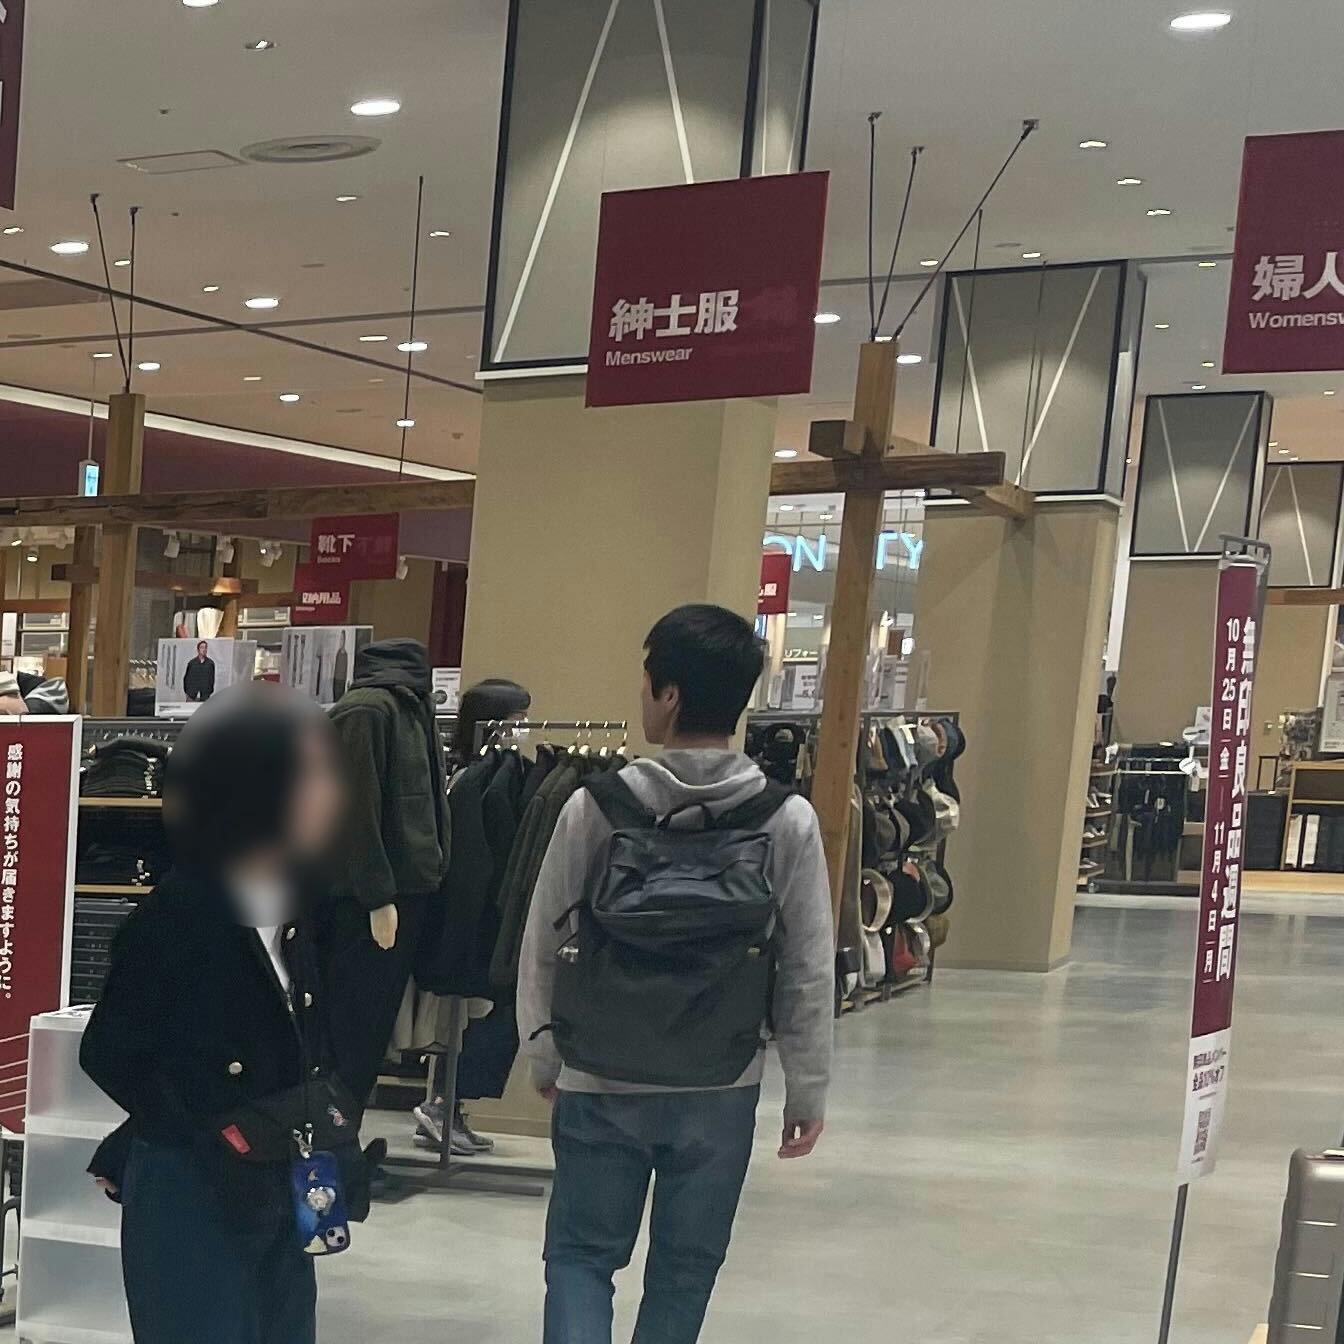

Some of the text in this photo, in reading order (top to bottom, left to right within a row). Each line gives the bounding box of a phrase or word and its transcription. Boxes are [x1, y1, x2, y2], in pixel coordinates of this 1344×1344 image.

[609, 290, 739, 342] 紳士服
[605, 348, 693, 366] Menswear
[318, 534, 355, 553] 靴下
